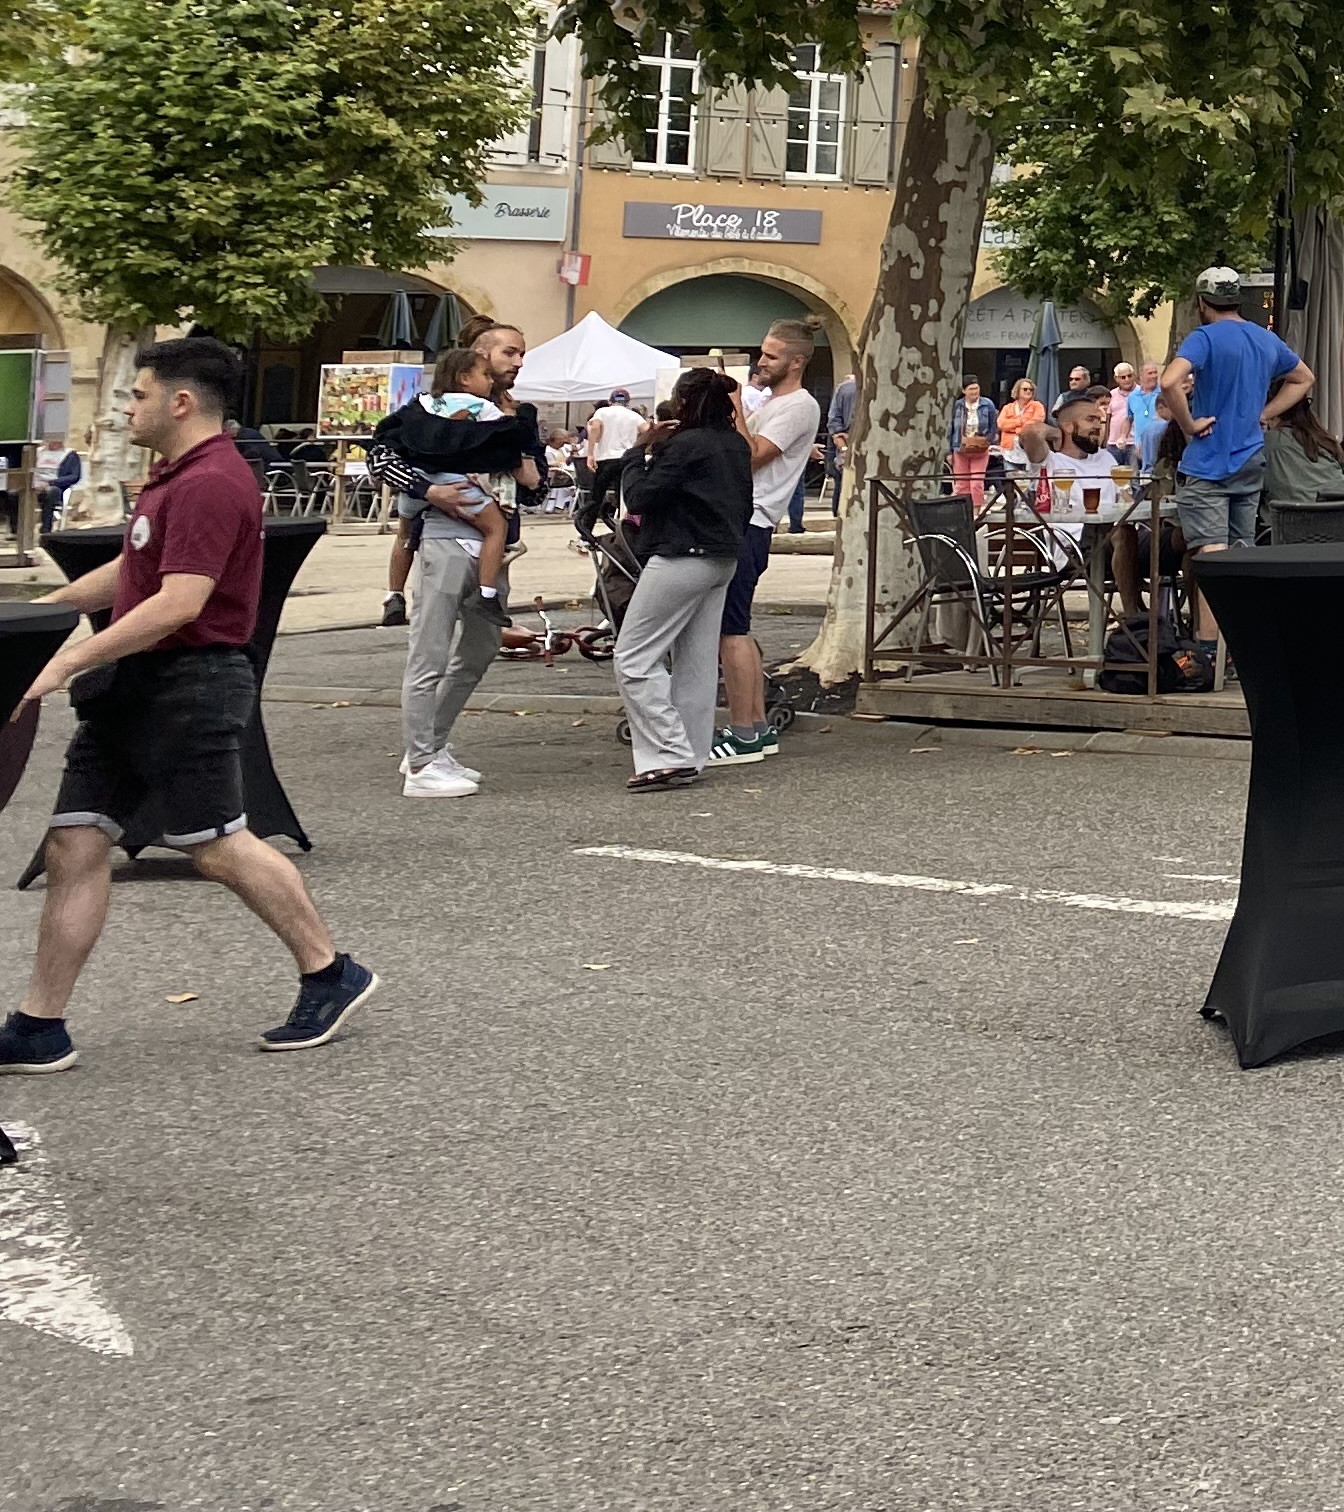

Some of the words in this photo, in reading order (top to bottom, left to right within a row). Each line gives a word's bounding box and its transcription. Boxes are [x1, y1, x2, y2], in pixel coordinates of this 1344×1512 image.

[494, 202, 551, 218] Brasserie
[671, 203, 743, 228] Place
[756, 210, 780, 228] 18
